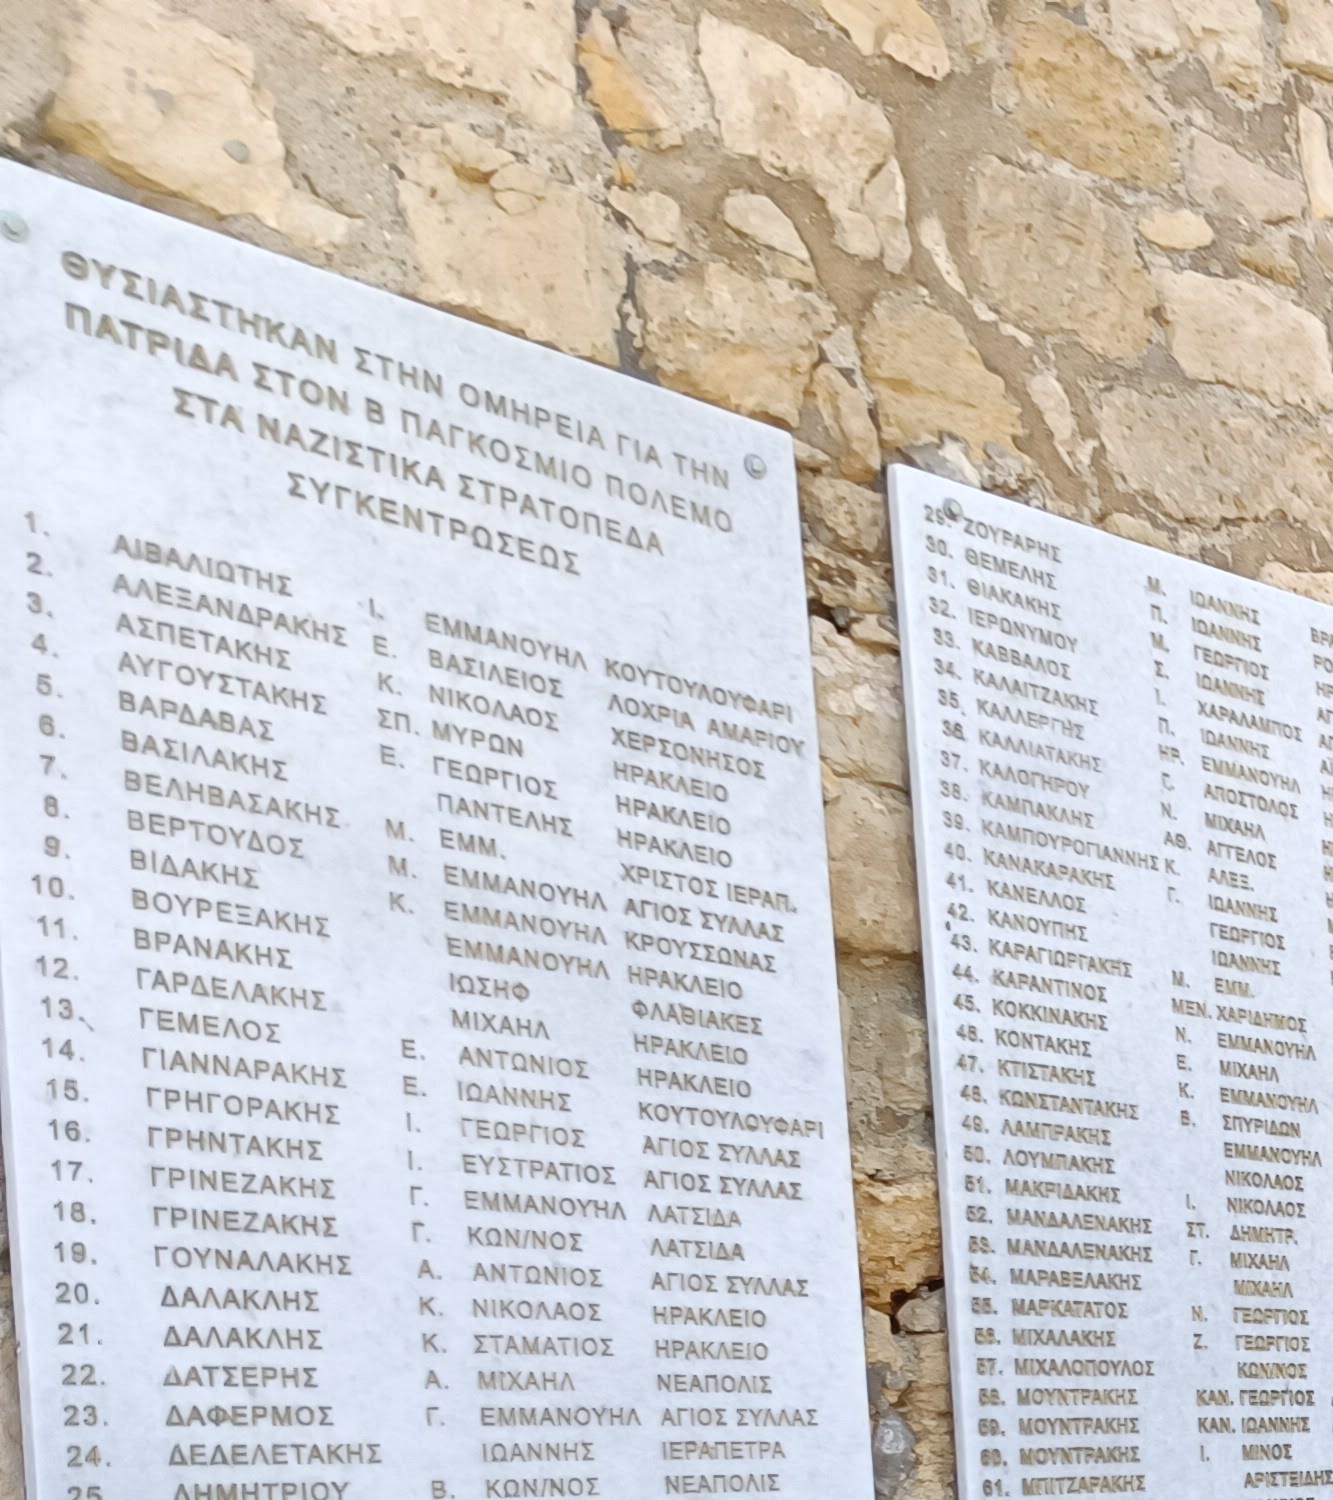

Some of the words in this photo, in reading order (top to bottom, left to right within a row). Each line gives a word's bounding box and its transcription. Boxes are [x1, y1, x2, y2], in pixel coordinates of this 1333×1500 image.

[60, 250, 339, 365] ΘΥΣΙΑΣΤΗΚΑΝ
[352, 345, 444, 400] ΣΤΗΝ
[458, 382, 606, 451] ΟΜΗΡΕΙΑ
[616, 431, 663, 469] ΓΙΑ
[671, 450, 730, 491] ΤΗΝ
[63, 300, 240, 383] ΠΑΤΡΙΔΑ
[251, 360, 351, 416] ΣΤΟΝ
[364, 396, 386, 426] Β
[399, 407, 593, 490] ΠΑΓΚΟΣΜΙΟ
[604, 472, 734, 534] ΠΟΛΕΜΟ
[171, 385, 245, 434] ΣΤΑ
[256, 412, 446, 493] ΝΑΖΙΣΤΙΚΑ
[457, 472, 665, 557] ΣΤΡΑΤΟΠΕΔΑ
[286, 470, 581, 578] ΣΥΓΚΕΝΤΡΩΣΕΩΣ
[110, 533, 294, 598] ΑΙΒΑΛΙΩΤΗΣ
[423, 611, 588, 672] ΕΜΜΑΝΟΥΗΛ
[603, 657, 794, 724] ΚΟΥΤΟΥΛΟΥΦΑΡΙ
[111, 573, 349, 648] ΑΛΕΞΑΝΔΡΑΚΗΣ
[427, 647, 565, 700] ΒΑΣΙΛΕΙΟΣ
[114, 612, 292, 672] ΑΣΠΕΤΑΚΗΣ
[427, 683, 560, 733] ΝΙΚΟΛΑΟΣ
[610, 726, 767, 781] ΧΕΡΣΟΝΗΣΟΣ
[117, 650, 328, 717] ΑΥΓΟΥΣΤΑΚΗΣ
[432, 719, 525, 758] ΜΥΡΩΝ
[612, 759, 730, 804] ΗΡΑΚΛΕΙΟ
[117, 689, 275, 743] ΒΑΡΔΑΒΑΣ
[431, 754, 559, 801] ΓΕΩΡΓΙΟΣ
[120, 728, 289, 783] ΒΑΣΙΛΑΚΗΣ
[436, 791, 575, 839] ΠΑΝΤΕΛΗΣ
[122, 768, 341, 830] ΒΕΛΗΒΑΣΑΚΗΣ
[126, 808, 308, 863] ΒΕΡΤΟΥΔΟΣ
[442, 863, 609, 913] ΕΜΜΑΝΟΥΗΛ
[128, 848, 260, 891] ΒΙΔΑΚΗΣ
[622, 930, 778, 975] ΚΡΟΥΣΣΩΝΑΣ
[130, 887, 331, 940] ΒΟΥΡΕΞΑΚΗΣ
[132, 926, 294, 971] ΒΡΑΝΑΚΗΣ
[448, 971, 531, 1003] ΙΩΣΗΦ
[135, 966, 327, 1013] ΓΑΡΔΕΛΑΚΗΣ
[138, 1006, 282, 1045] ΓΕΜΕΛΟΣ
[457, 1045, 590, 1081] ΑΝΤΩΝΙΟΣ
[141, 1045, 348, 1090] ΓΙΑΝΝΑΡΑΚΗΣ
[145, 1085, 341, 1126] ΓΡΗΓΟΡΑΚΗΣ
[146, 1125, 324, 1162] ΓΡΗΝΤΑΚΗΣ
[460, 1152, 617, 1186] ΕΥΣΤΡΑΤΙΟΣ
[147, 1164, 336, 1201] ΓΡΙΝΕΖΑΚΗΣ
[646, 1203, 743, 1229] ΛΑΤΣΙΔΑ
[151, 1204, 339, 1239] ΓΡΙΝΕΖΑΚΗΣ
[466, 1225, 584, 1253] ΚΩΝ/ΝΟΣ
[153, 1244, 354, 1277] ΓΟΥΝΑΛΑΚΗΣ
[159, 1284, 320, 1313] ΔΑΛΑΚΛΗΣ
[471, 1297, 603, 1322] ΝΙΚΟΛΑΟΣ
[162, 1324, 324, 1351] ΔΑΛΑΚΛΗΣ
[472, 1333, 615, 1358] ΣΤΑΜΑΤΙΟΣ
[161, 1364, 319, 1390] ΔΑΤΣΕΡΗΣ
[655, 1373, 773, 1395] ΝΕΑΠΟΛΙΣ
[164, 1404, 335, 1428] ΔΑΦΕΡΜΟΣ
[167, 1442, 384, 1467] ΔΕΔΕΛΕΤΑΚΗΣ
[660, 1440, 787, 1461] ΙΕΡΑΠΕΤΡΑ
